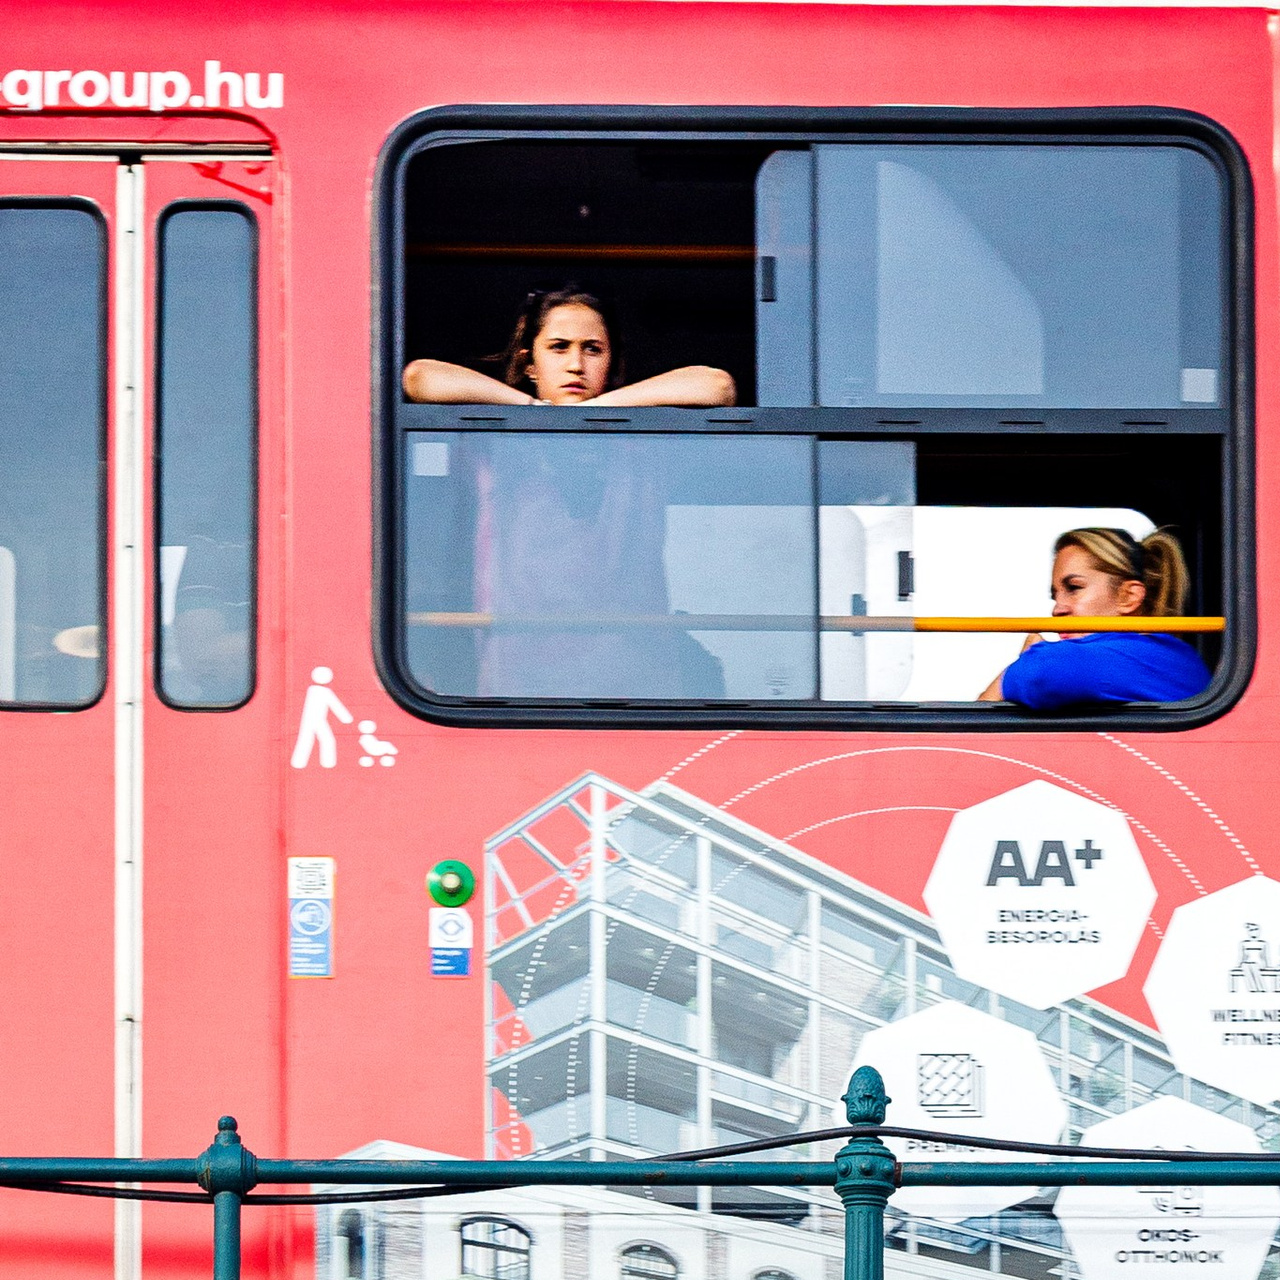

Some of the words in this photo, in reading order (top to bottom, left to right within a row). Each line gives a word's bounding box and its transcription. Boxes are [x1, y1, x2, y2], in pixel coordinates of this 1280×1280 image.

[0, 60, 284, 112] group.hu
[986, 839, 1103, 886] AA+
[998, 910, 1089, 922] ENERGIA-
[986, 927, 1101, 943] BESOROLÁS
[1115, 1250, 1224, 1263] OTTHONOK
